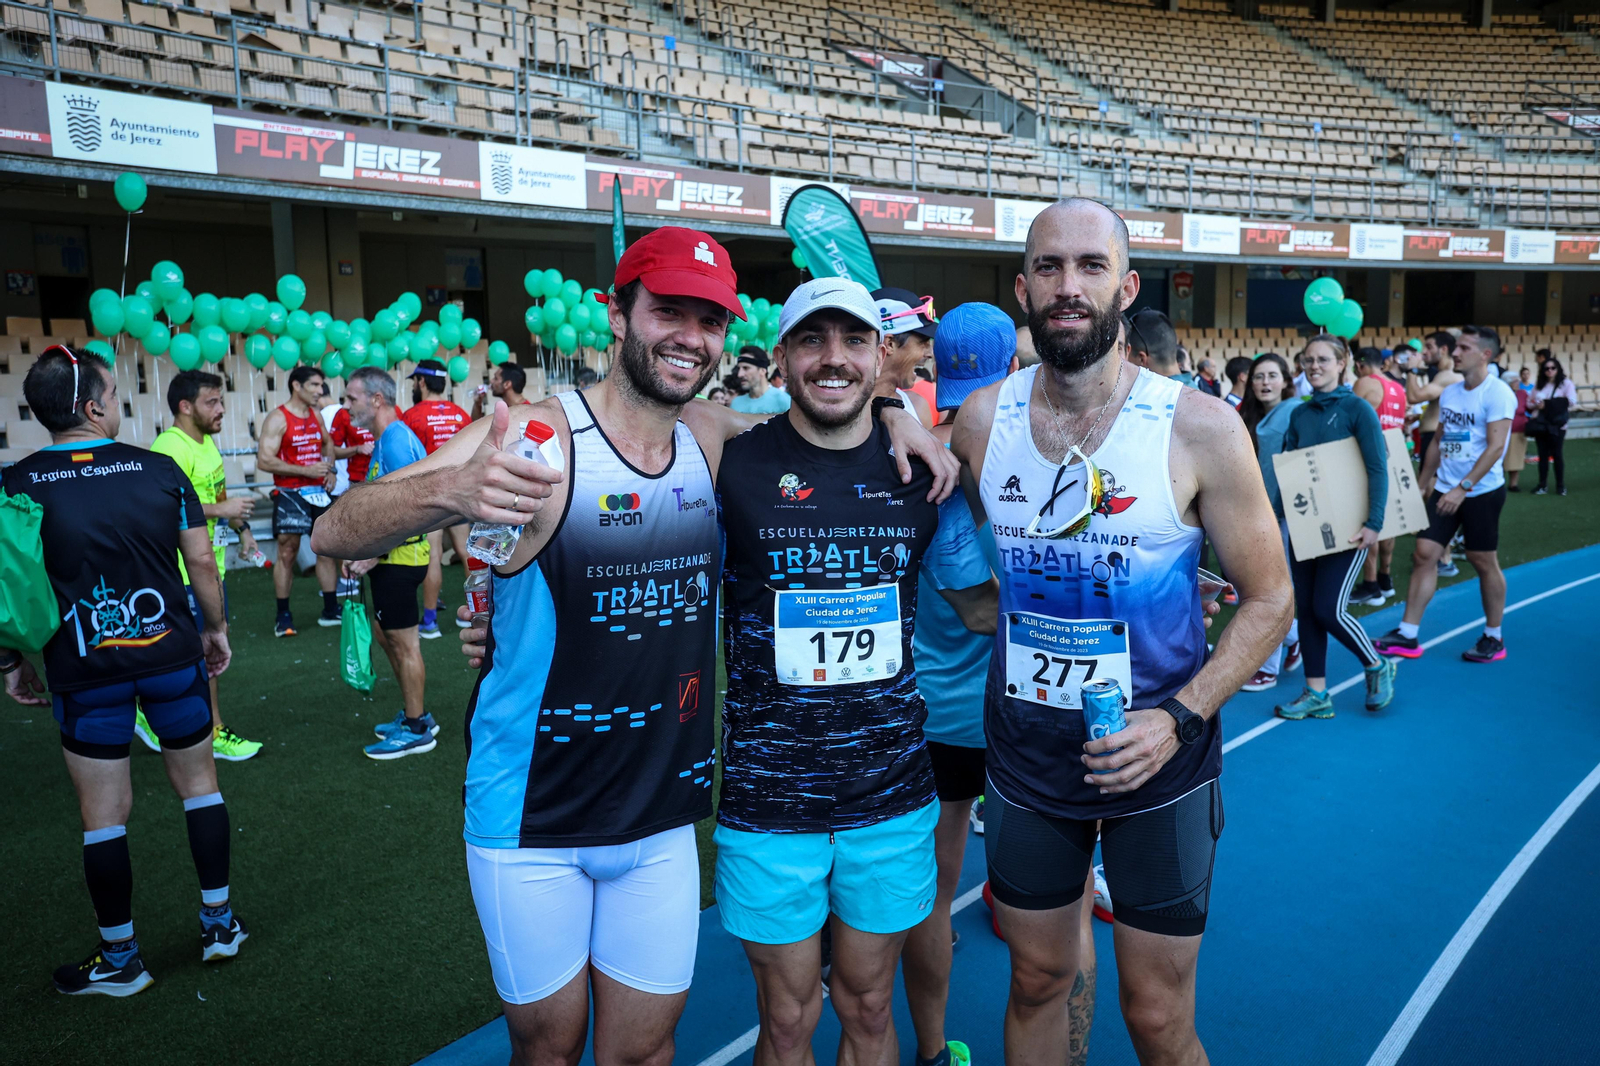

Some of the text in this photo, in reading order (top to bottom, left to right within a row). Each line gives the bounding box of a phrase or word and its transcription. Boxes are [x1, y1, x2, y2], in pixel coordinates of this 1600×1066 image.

[0, 128, 42, 142] OMPITE.
[110, 118, 200, 139] Ayuntamiento
[111, 130, 163, 146] de Jerez
[235, 128, 336, 163] PLAY
[518, 166, 577, 183] Ayuntamiento
[518, 177, 552, 190] de Jerez
[859, 200, 914, 220] PLAY
[1127, 219, 1166, 238] EREZ
[1246, 228, 1288, 244] PLAY
[1408, 236, 1450, 250] PLAY
[29, 460, 143, 484] Legion Española
[886, 498, 904, 506] Xerez
[795, 591, 887, 605] XLIII Carrera Popular
[805, 605, 878, 617] Ciudad de Jerez
[143, 622, 166, 634] años
[1021, 616, 1112, 634] XLIII Carrera Popular
[1029, 630, 1100, 646] Ciudad de Jerez
[809, 629, 875, 664] 179
[1048, 644, 1070, 652] Noviembre
[1033, 653, 1098, 688] 277
